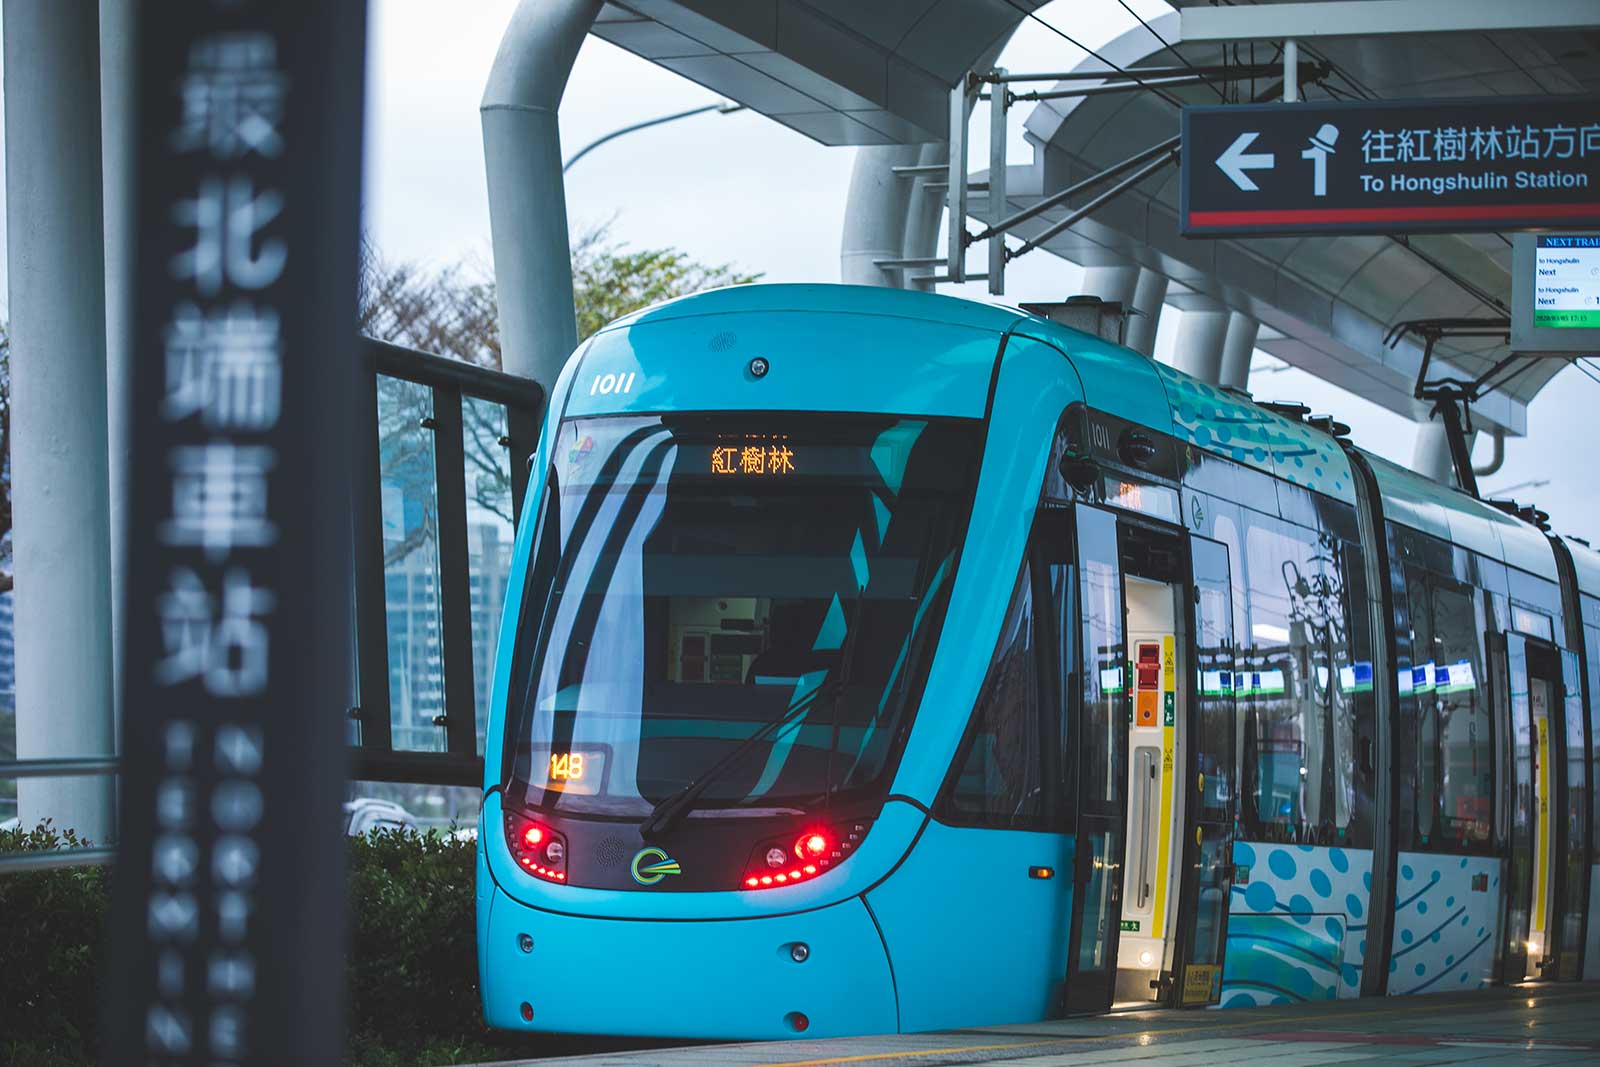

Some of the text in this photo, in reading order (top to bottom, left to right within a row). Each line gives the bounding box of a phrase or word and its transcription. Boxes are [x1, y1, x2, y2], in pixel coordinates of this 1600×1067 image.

[1361, 123, 1600, 164] 往紅樹林站方向
[1360, 170, 1588, 195] To Hongshulin Station
[1546, 237, 1573, 247] NEXT
[157, 30, 289, 698] 最北端車站
[590, 372, 635, 396] 1011
[1091, 423, 1111, 450] 1011
[712, 445, 795, 474] 紅樹林
[551, 753, 583, 780] 148
